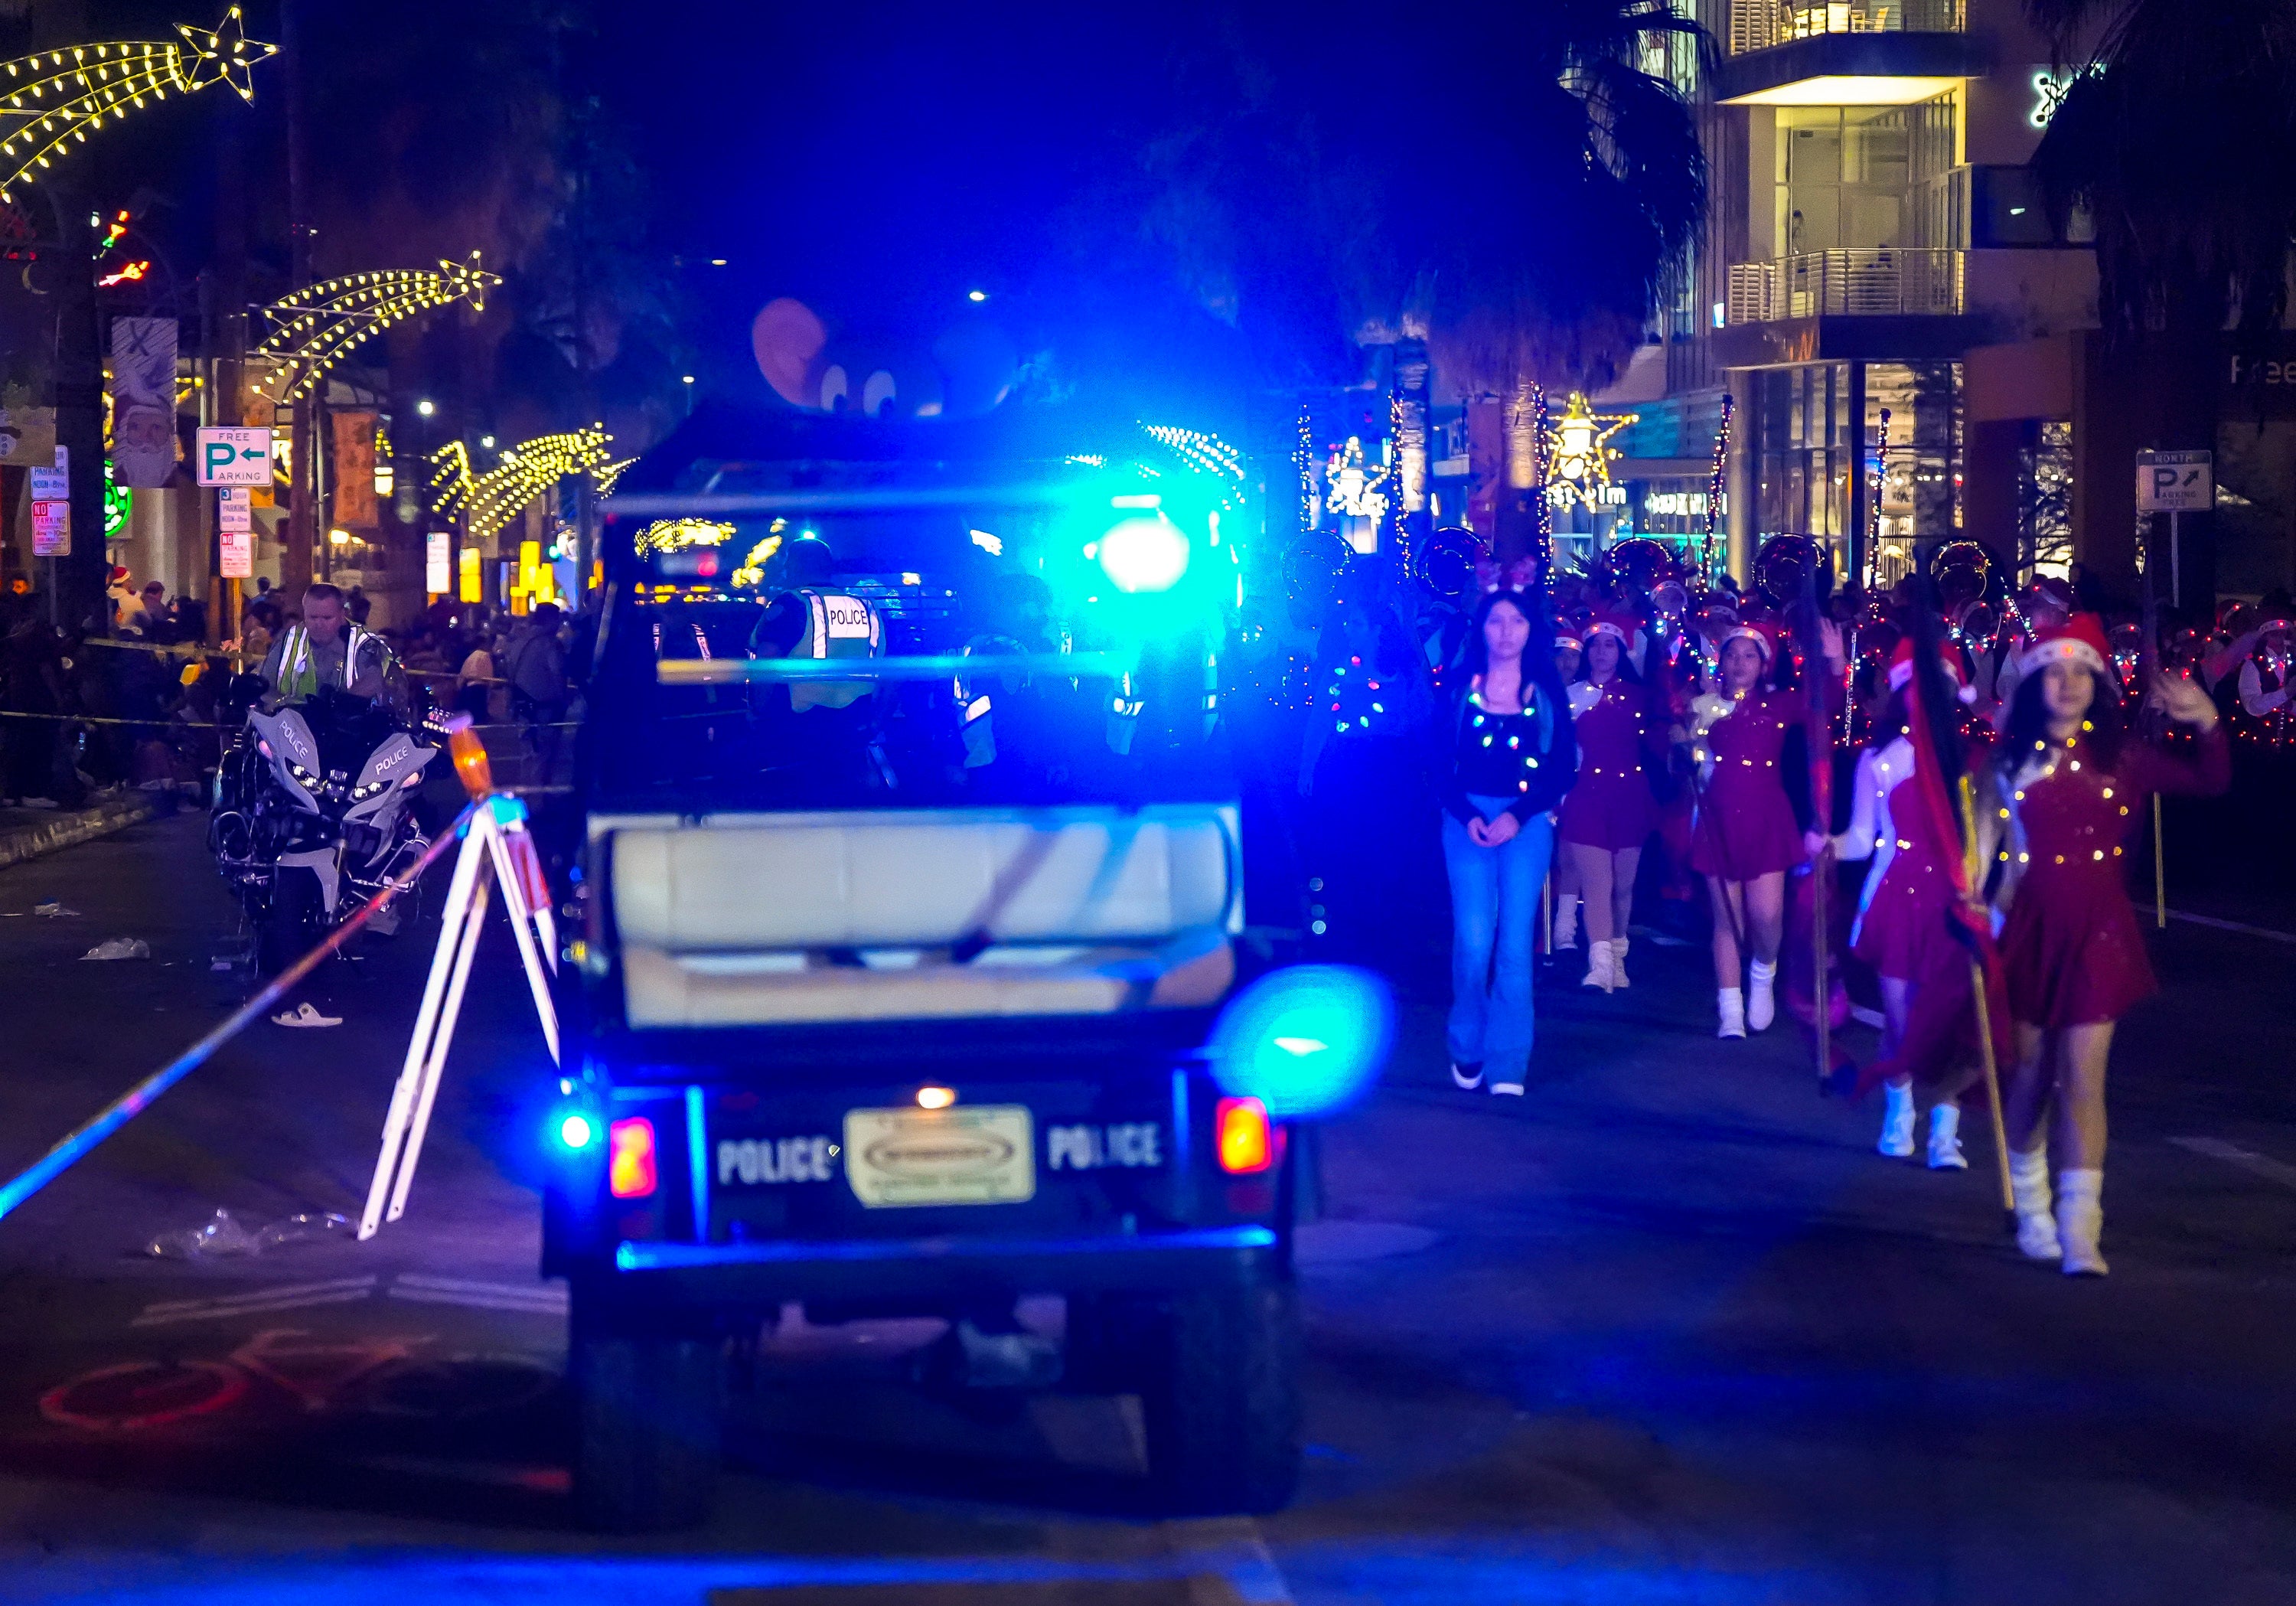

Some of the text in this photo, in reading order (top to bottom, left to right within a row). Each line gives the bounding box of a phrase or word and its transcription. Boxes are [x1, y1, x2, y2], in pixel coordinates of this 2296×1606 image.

[219, 433, 250, 441] FREE
[2154, 454, 2194, 463] NORTH
[222, 489, 230, 499] 3
[34, 504, 47, 515] NO
[222, 504, 248, 512] PARKING
[222, 534, 233, 544] NO
[830, 609, 868, 625] POLICE
[279, 721, 308, 759] POLICE
[375, 746, 408, 775] POLICE
[1047, 1121, 1162, 1171] POLICE
[717, 1134, 833, 1186] POLICE
